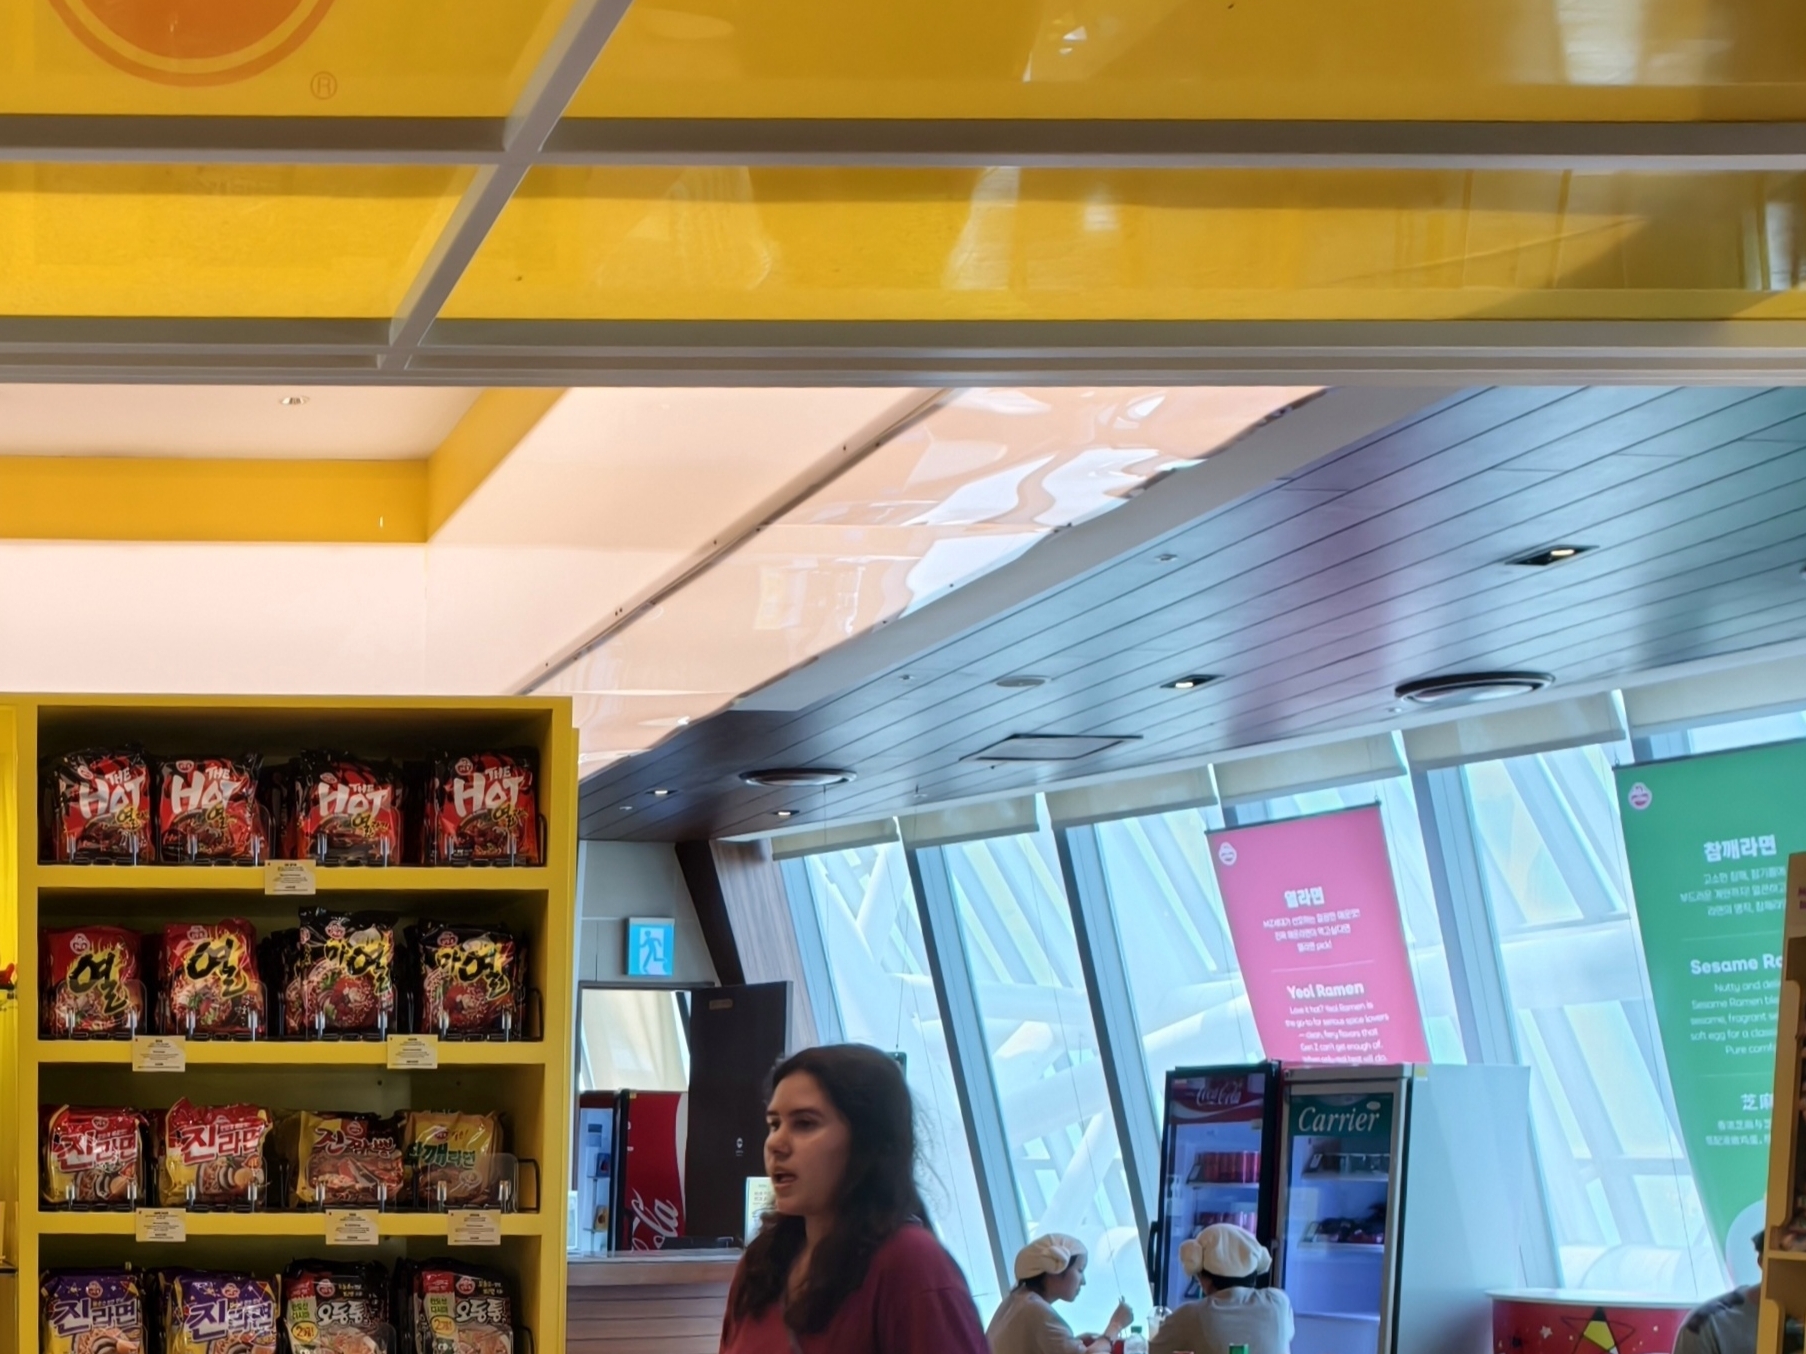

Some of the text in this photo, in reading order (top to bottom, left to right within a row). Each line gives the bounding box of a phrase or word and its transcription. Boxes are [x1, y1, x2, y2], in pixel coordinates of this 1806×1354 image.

[105, 767, 132, 785] THE
[206, 767, 230, 780] THE
[485, 766, 512, 781] THE
[79, 774, 146, 819] HOT
[171, 770, 245, 815] HOT
[317, 782, 391, 818] HOT
[349, 783, 375, 793] THE
[453, 772, 524, 818] HOT
[1703, 834, 1777, 863] 참깨라면
[1690, 957, 1758, 975] Sesame
[1286, 982, 1365, 999] Yeol Ramen
[1728, 1013, 1766, 1026] fragrant
[1298, 1106, 1381, 1132] Carrier
[180, 1124, 264, 1166] 진라면
[53, 1298, 138, 1338] 진라면
